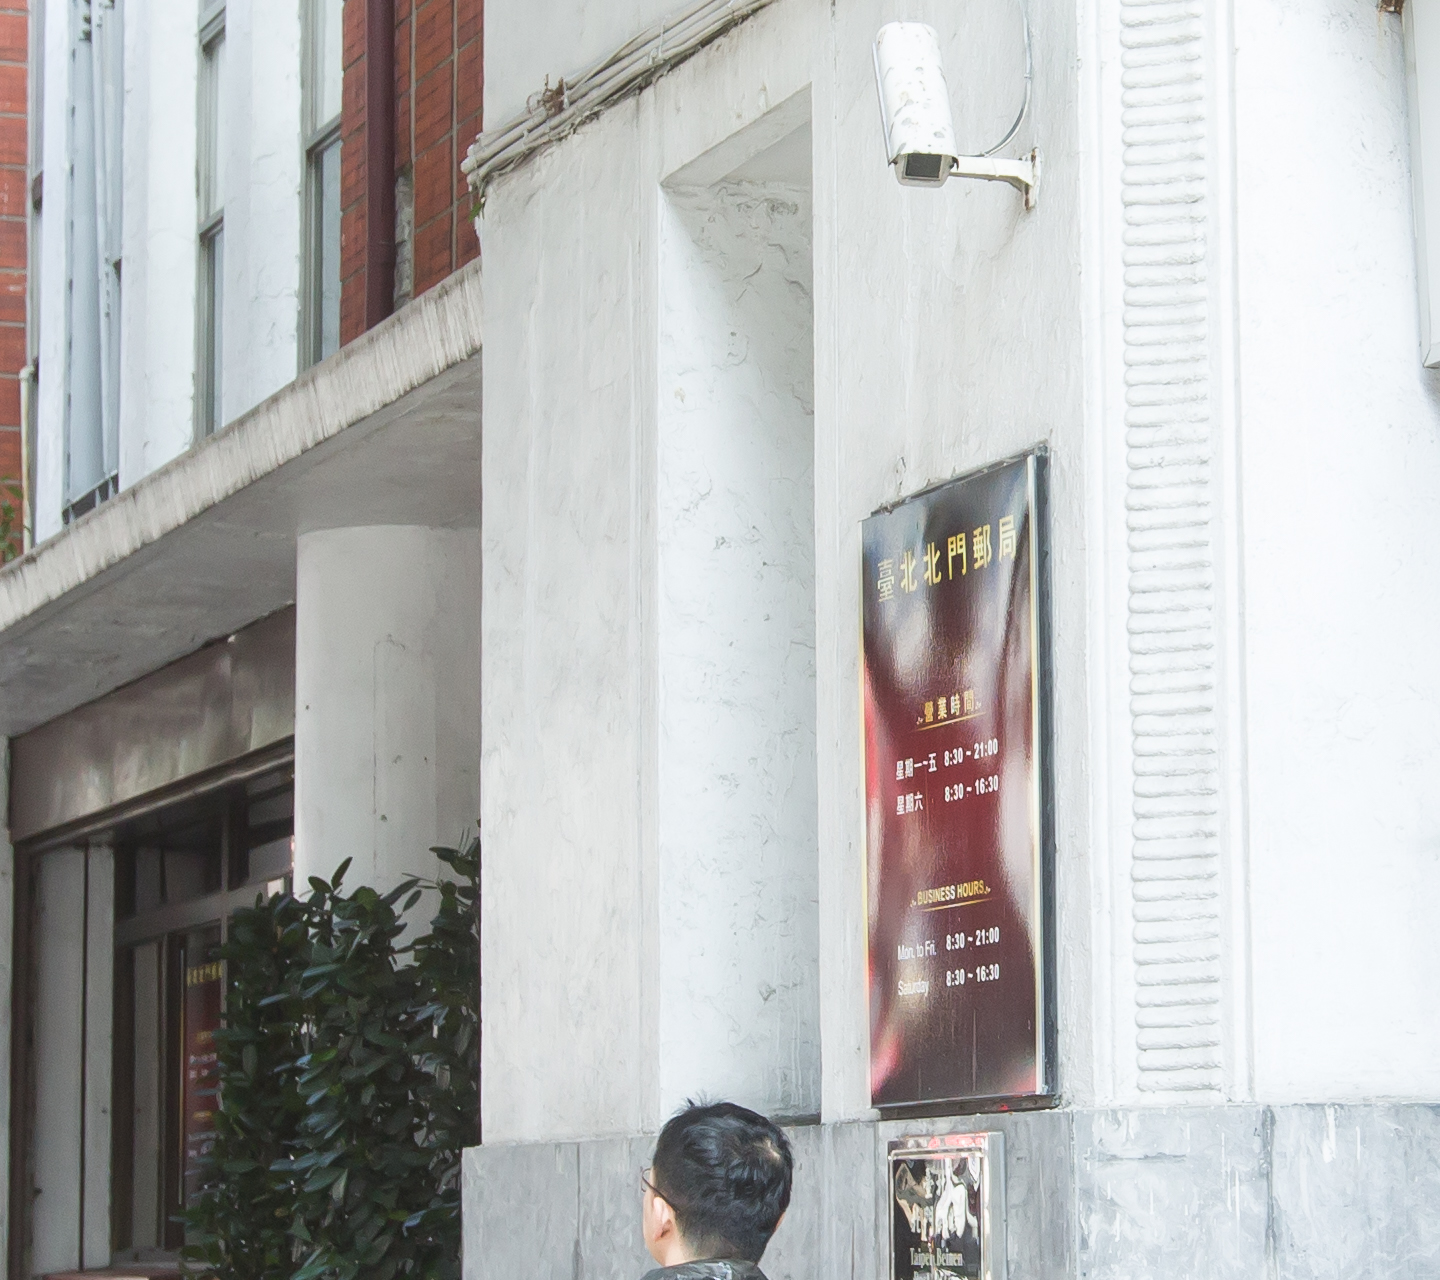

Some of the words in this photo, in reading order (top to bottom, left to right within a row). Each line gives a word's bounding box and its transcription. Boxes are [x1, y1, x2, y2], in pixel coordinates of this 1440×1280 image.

[876, 514, 1017, 603] 臺北北門郵局
[924, 689, 975, 723] 營業時間
[944, 747, 964, 767] 8:30
[973, 738, 999, 760] 21:00
[896, 791, 924, 815] 星期六
[944, 782, 964, 802] 8:30
[974, 775, 999, 796] 16:30
[917, 884, 956, 906] BUSINESS
[957, 880, 985, 899] HOURS
[917, 943, 925, 958] to
[925, 940, 937, 957] Fri.
[946, 931, 965, 951] 8:30
[975, 926, 1000, 946] 21:00
[897, 979, 930, 997] Saturday
[946, 968, 965, 987] 8:30
[975, 963, 1000, 982] 16:30
